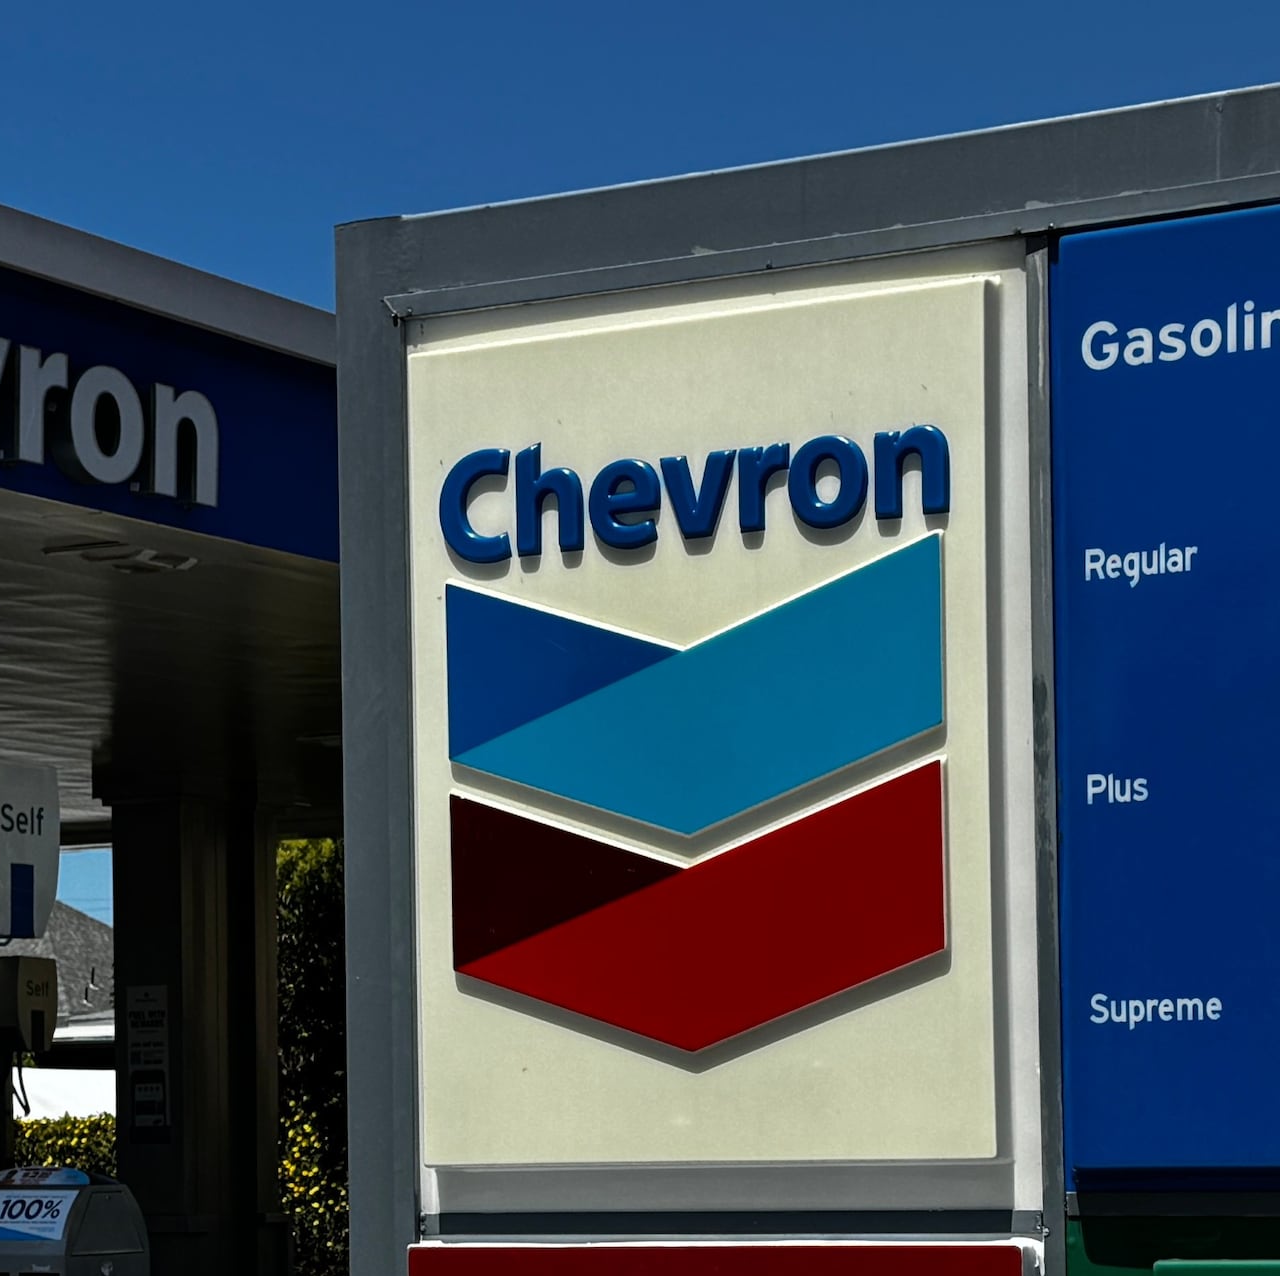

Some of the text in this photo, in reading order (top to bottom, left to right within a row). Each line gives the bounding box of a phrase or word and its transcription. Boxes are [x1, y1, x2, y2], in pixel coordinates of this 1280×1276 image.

[439, 424, 950, 564] Chevron
[1084, 542, 1198, 588] Regular
[1086, 773, 1149, 805] Plus
[0, 804, 44, 836] Self
[25, 980, 49, 997] Self
[1089, 993, 1222, 1030] Supreme
[0, 1199, 62, 1219] 100%
